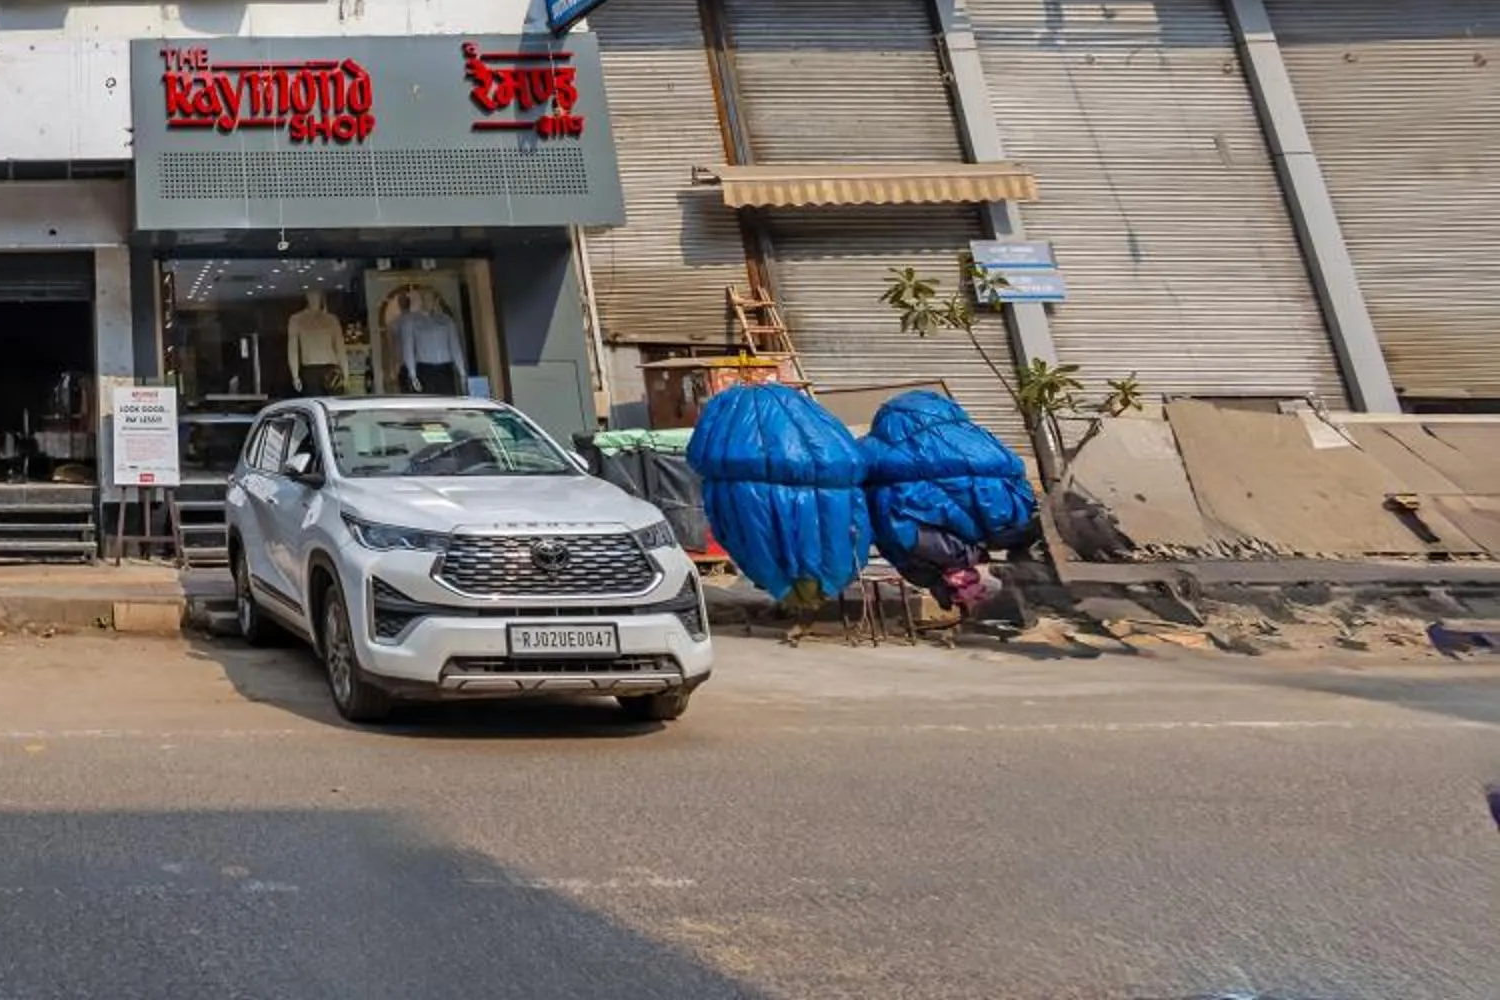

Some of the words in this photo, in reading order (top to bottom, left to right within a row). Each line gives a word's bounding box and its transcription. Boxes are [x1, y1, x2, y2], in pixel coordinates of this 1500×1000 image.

[160, 46, 208, 70] THE
[163, 59, 374, 132] Raymond
[290, 113, 377, 143] SHOP
[521, 631, 612, 648] RJ02UE0047
